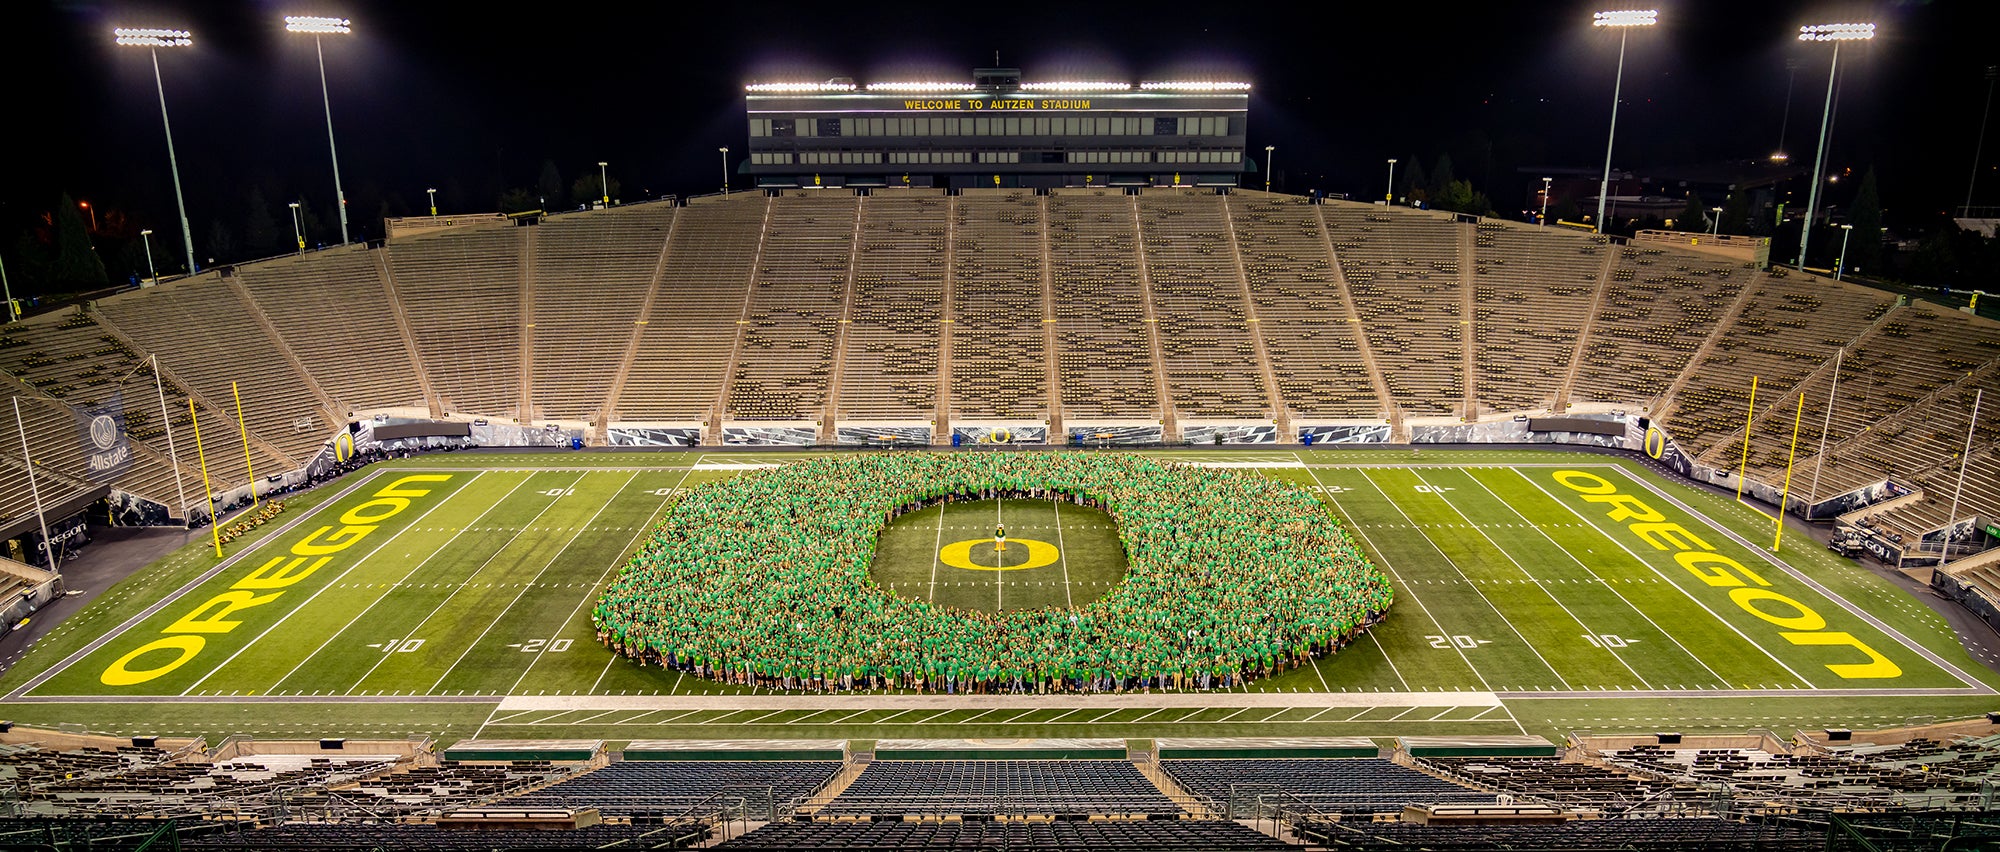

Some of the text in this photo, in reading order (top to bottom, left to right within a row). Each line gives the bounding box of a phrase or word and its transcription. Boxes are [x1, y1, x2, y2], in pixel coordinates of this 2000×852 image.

[904, 99, 1091, 110] WELCOME TO AUTZEN STADIUM
[89, 446, 128, 470] Allstate
[939, 538, 1060, 571] O
[100, 473, 453, 687] OREGON
[1552, 469, 1904, 680] OREGON
[381, 638, 427, 653] 10
[520, 638, 575, 653] 20
[1424, 635, 1478, 649] 20
[1581, 634, 1628, 648] 10
